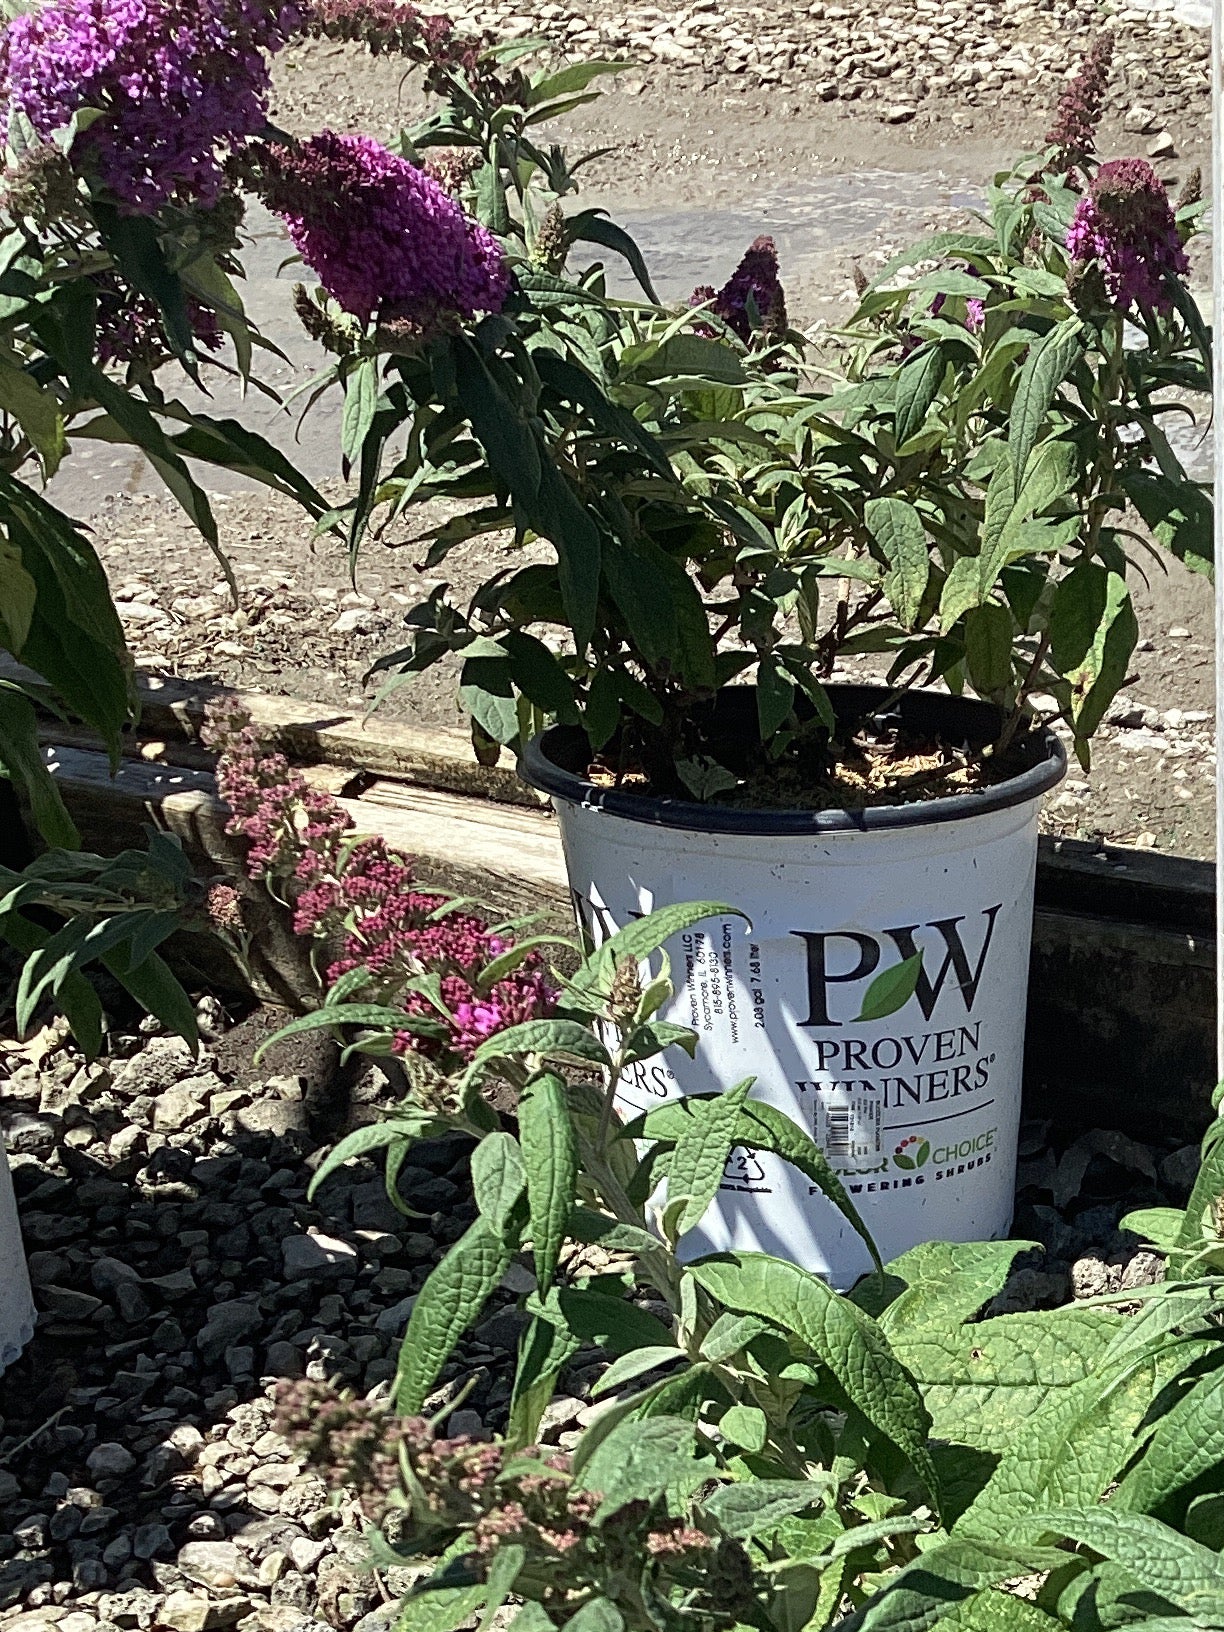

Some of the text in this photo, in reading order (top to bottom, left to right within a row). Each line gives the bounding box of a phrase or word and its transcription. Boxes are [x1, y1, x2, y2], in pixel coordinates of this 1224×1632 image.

[695, 932, 706, 965] 60178
[788, 903, 1003, 1027] PW
[682, 934, 700, 1026] Proven Winners LLC
[749, 961, 761, 983] 7.68
[752, 988, 765, 1005] gal
[813, 1021, 982, 1072] PROVEN
[736, 1156, 748, 1170] 2
[808, 1152, 992, 1195] FWERING SHRUBS
